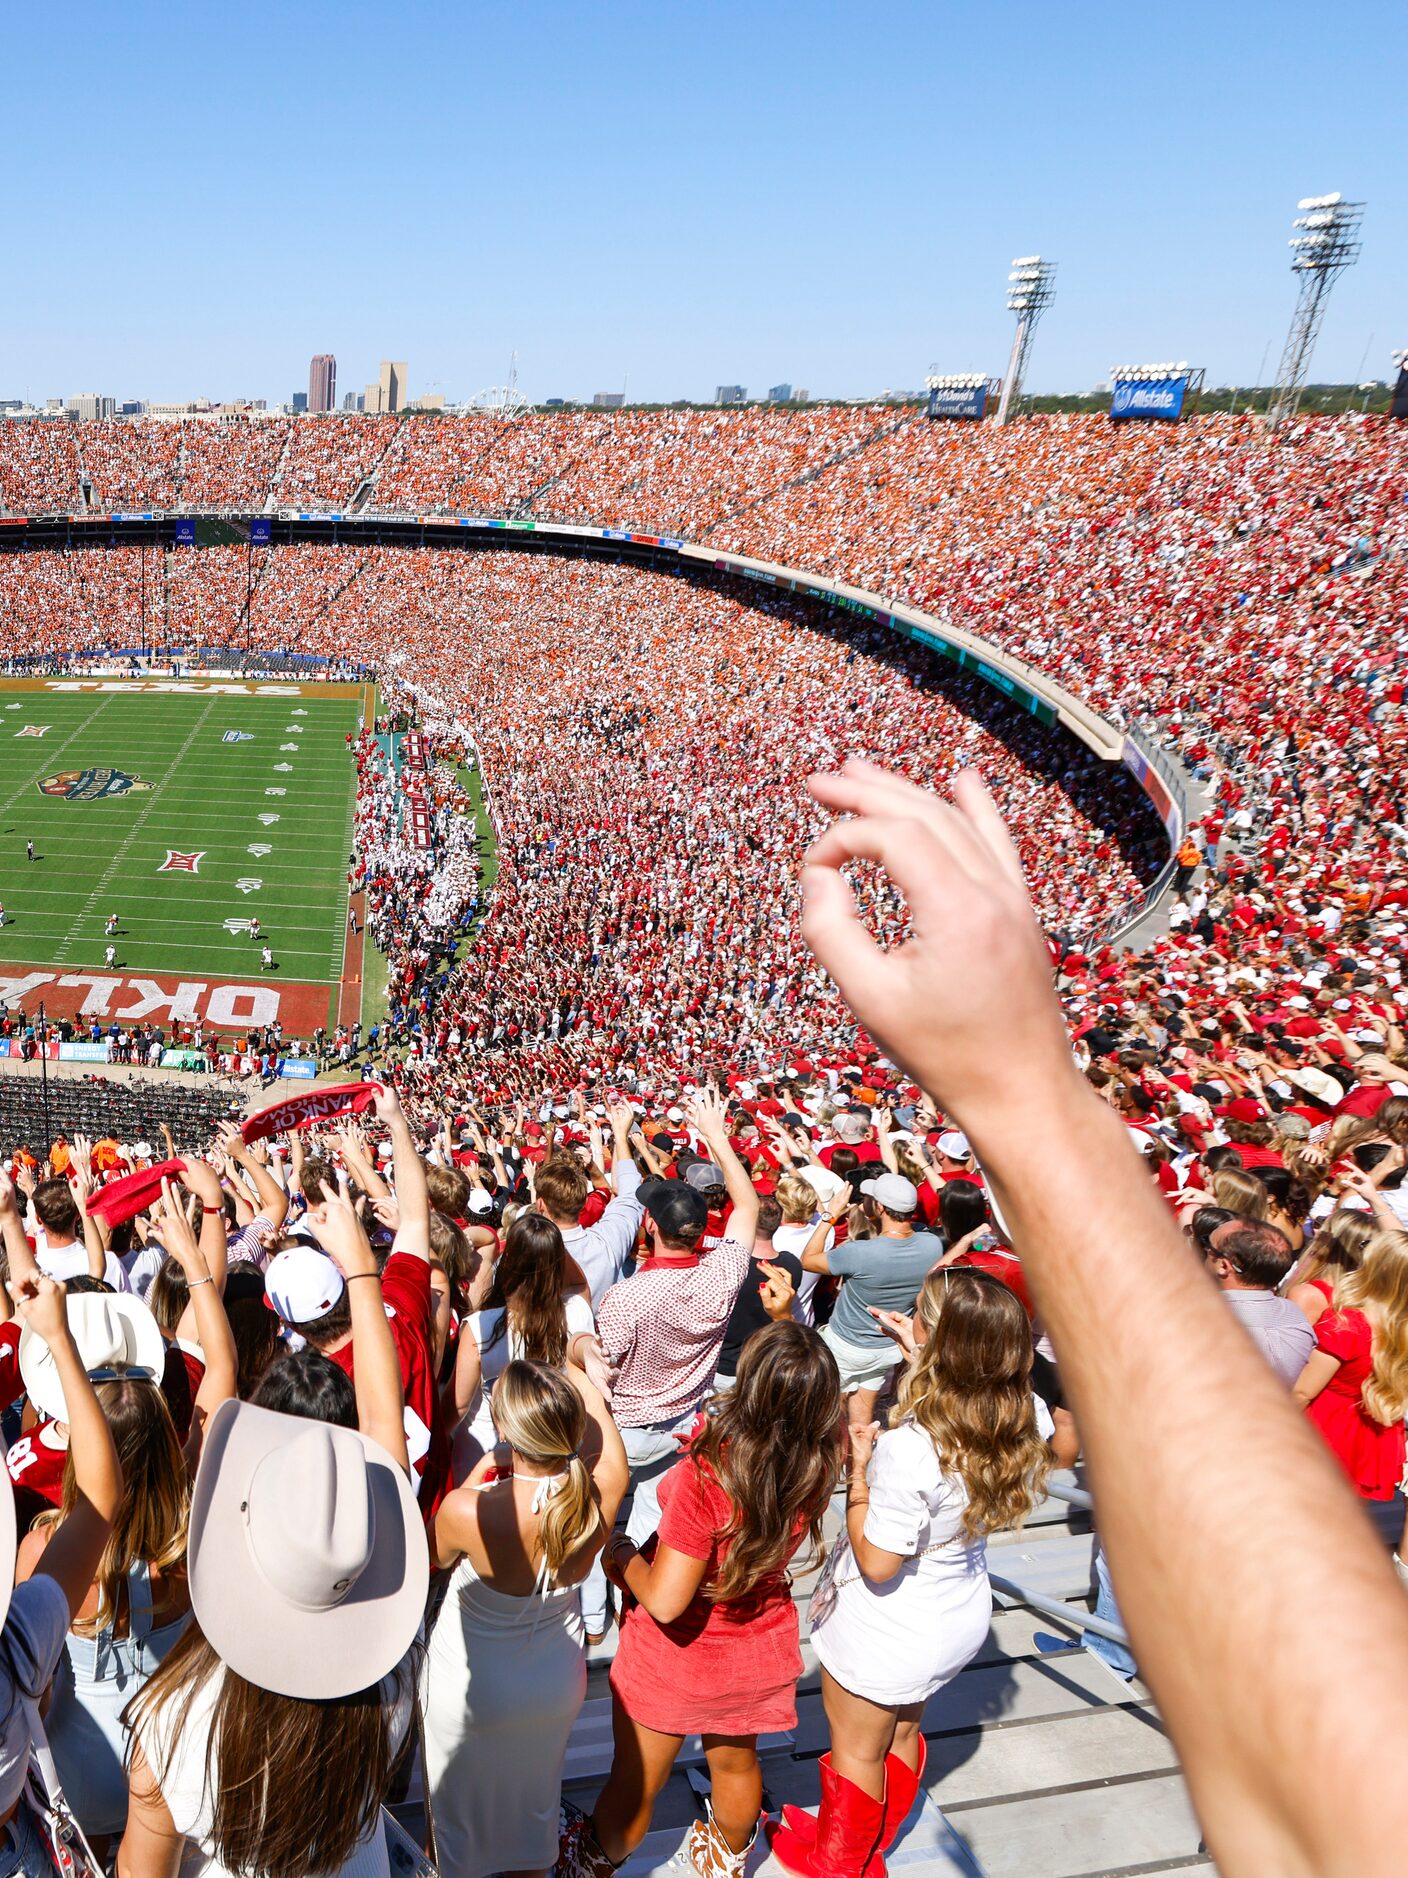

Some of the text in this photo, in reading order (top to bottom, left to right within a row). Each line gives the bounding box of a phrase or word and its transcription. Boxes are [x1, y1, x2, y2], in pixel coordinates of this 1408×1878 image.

[1129, 389, 1175, 408] Allstate
[44, 681, 302, 696] TEXAS
[272, 1114, 296, 1132] OF
[6, 1436, 39, 1481] 81
